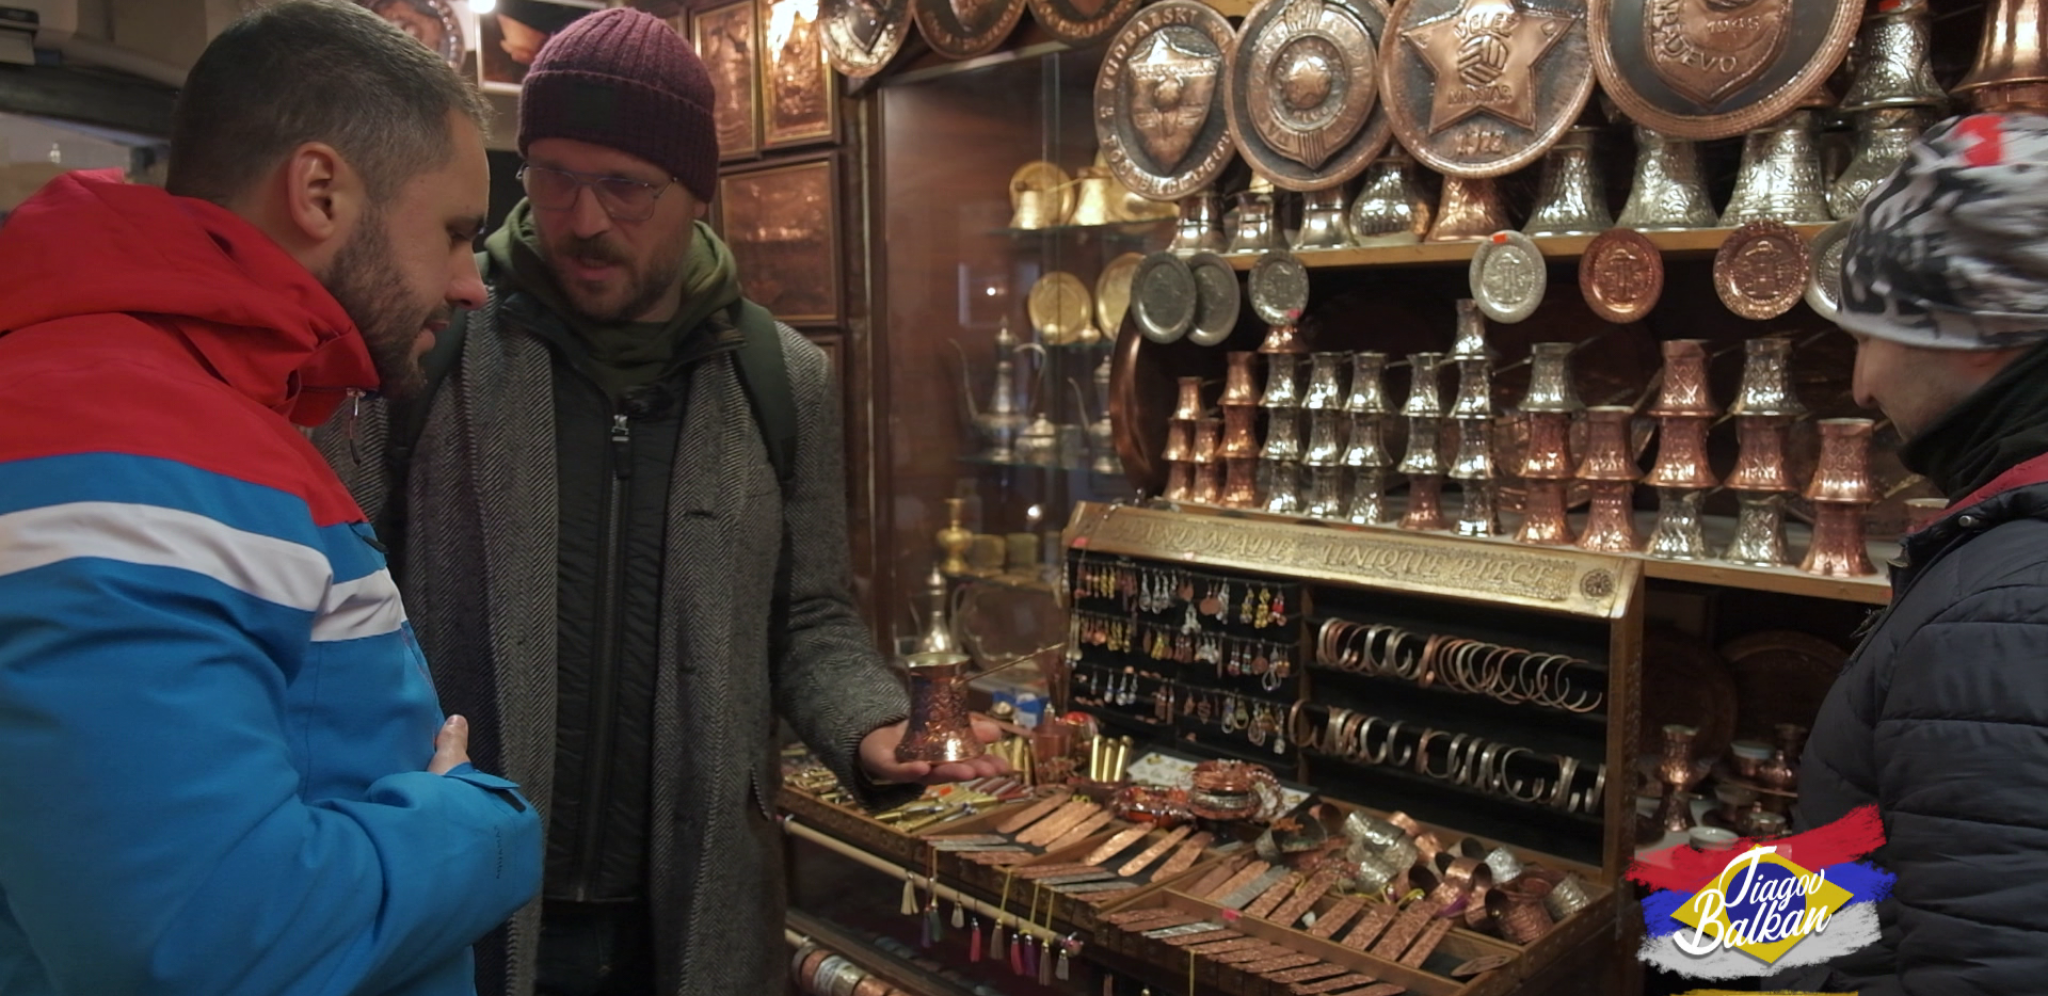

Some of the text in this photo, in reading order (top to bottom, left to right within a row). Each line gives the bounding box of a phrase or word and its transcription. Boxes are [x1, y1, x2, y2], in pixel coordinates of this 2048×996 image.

[1202, 530, 1294, 560] MADE
[1321, 542, 1446, 578] UNIQUE
[1452, 557, 1552, 587] PIECE
